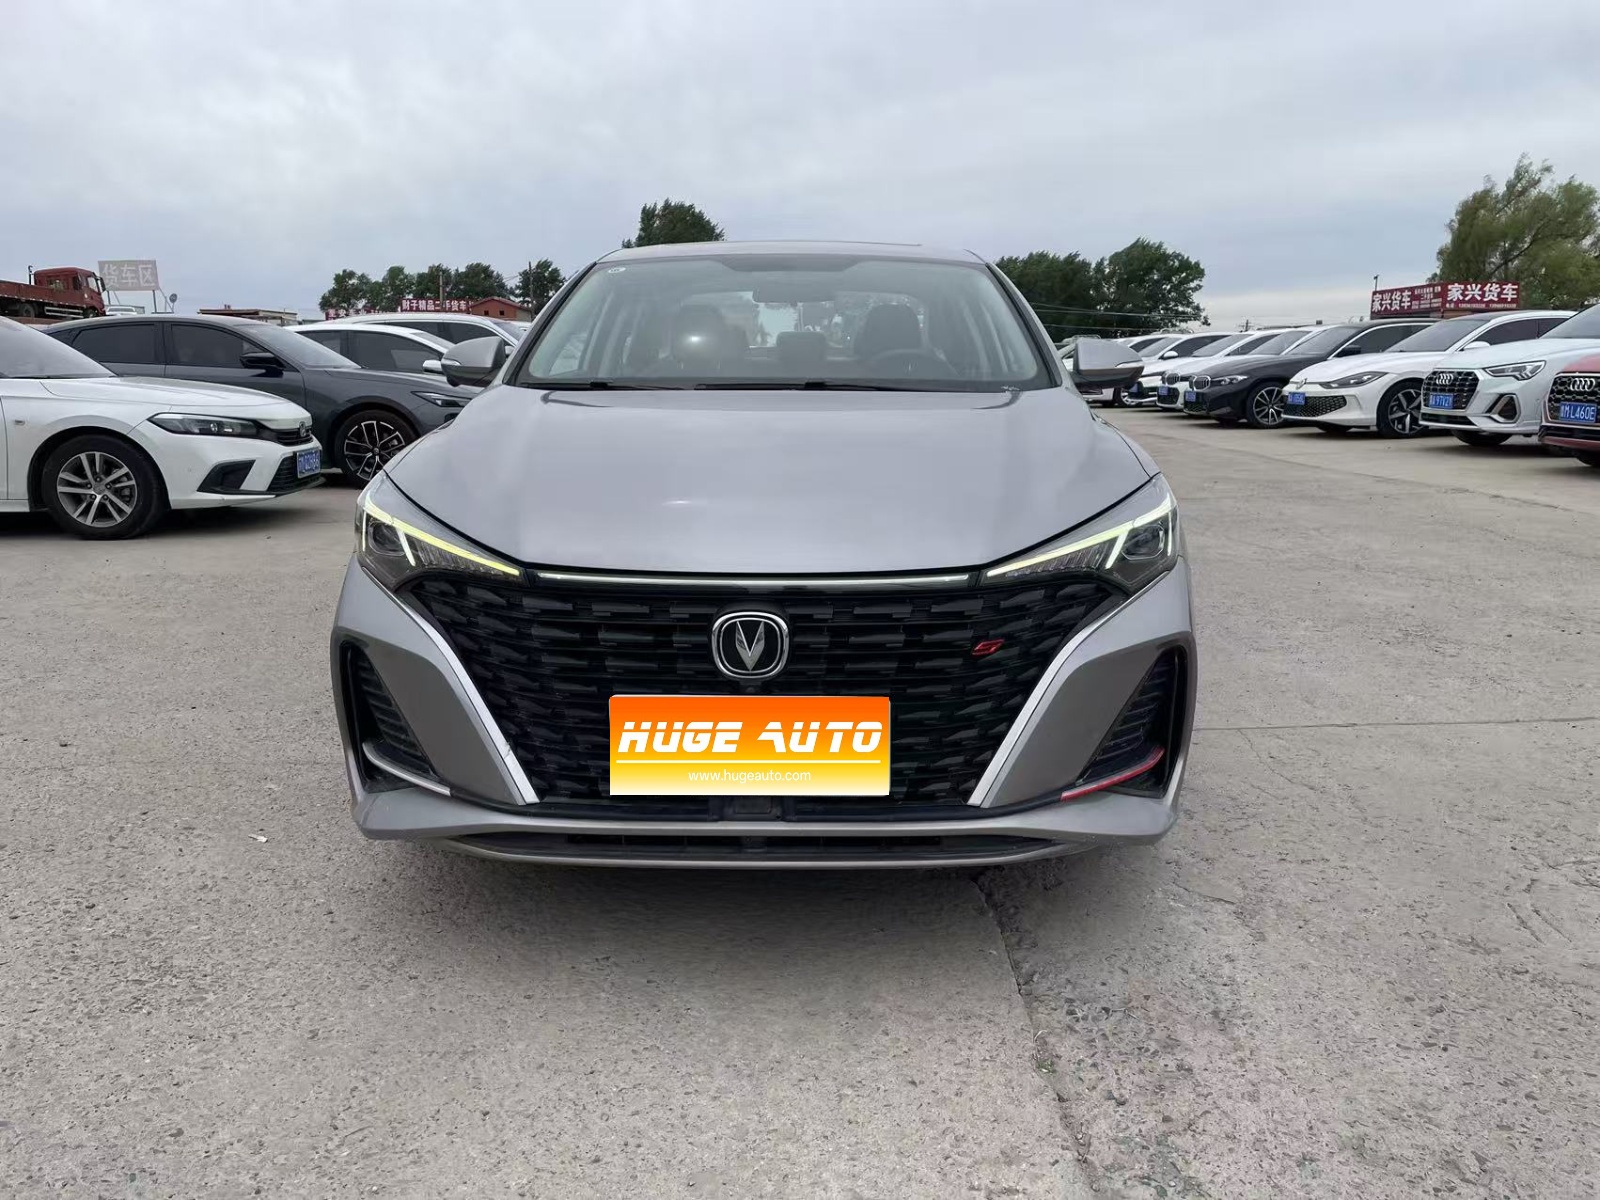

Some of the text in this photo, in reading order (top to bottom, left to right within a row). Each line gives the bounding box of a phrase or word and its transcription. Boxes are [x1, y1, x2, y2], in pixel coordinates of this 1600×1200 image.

[103, 263, 156, 288] 货车区
[1371, 290, 1412, 313] 家兴货车
[1447, 283, 1518, 302] 家兴货车
